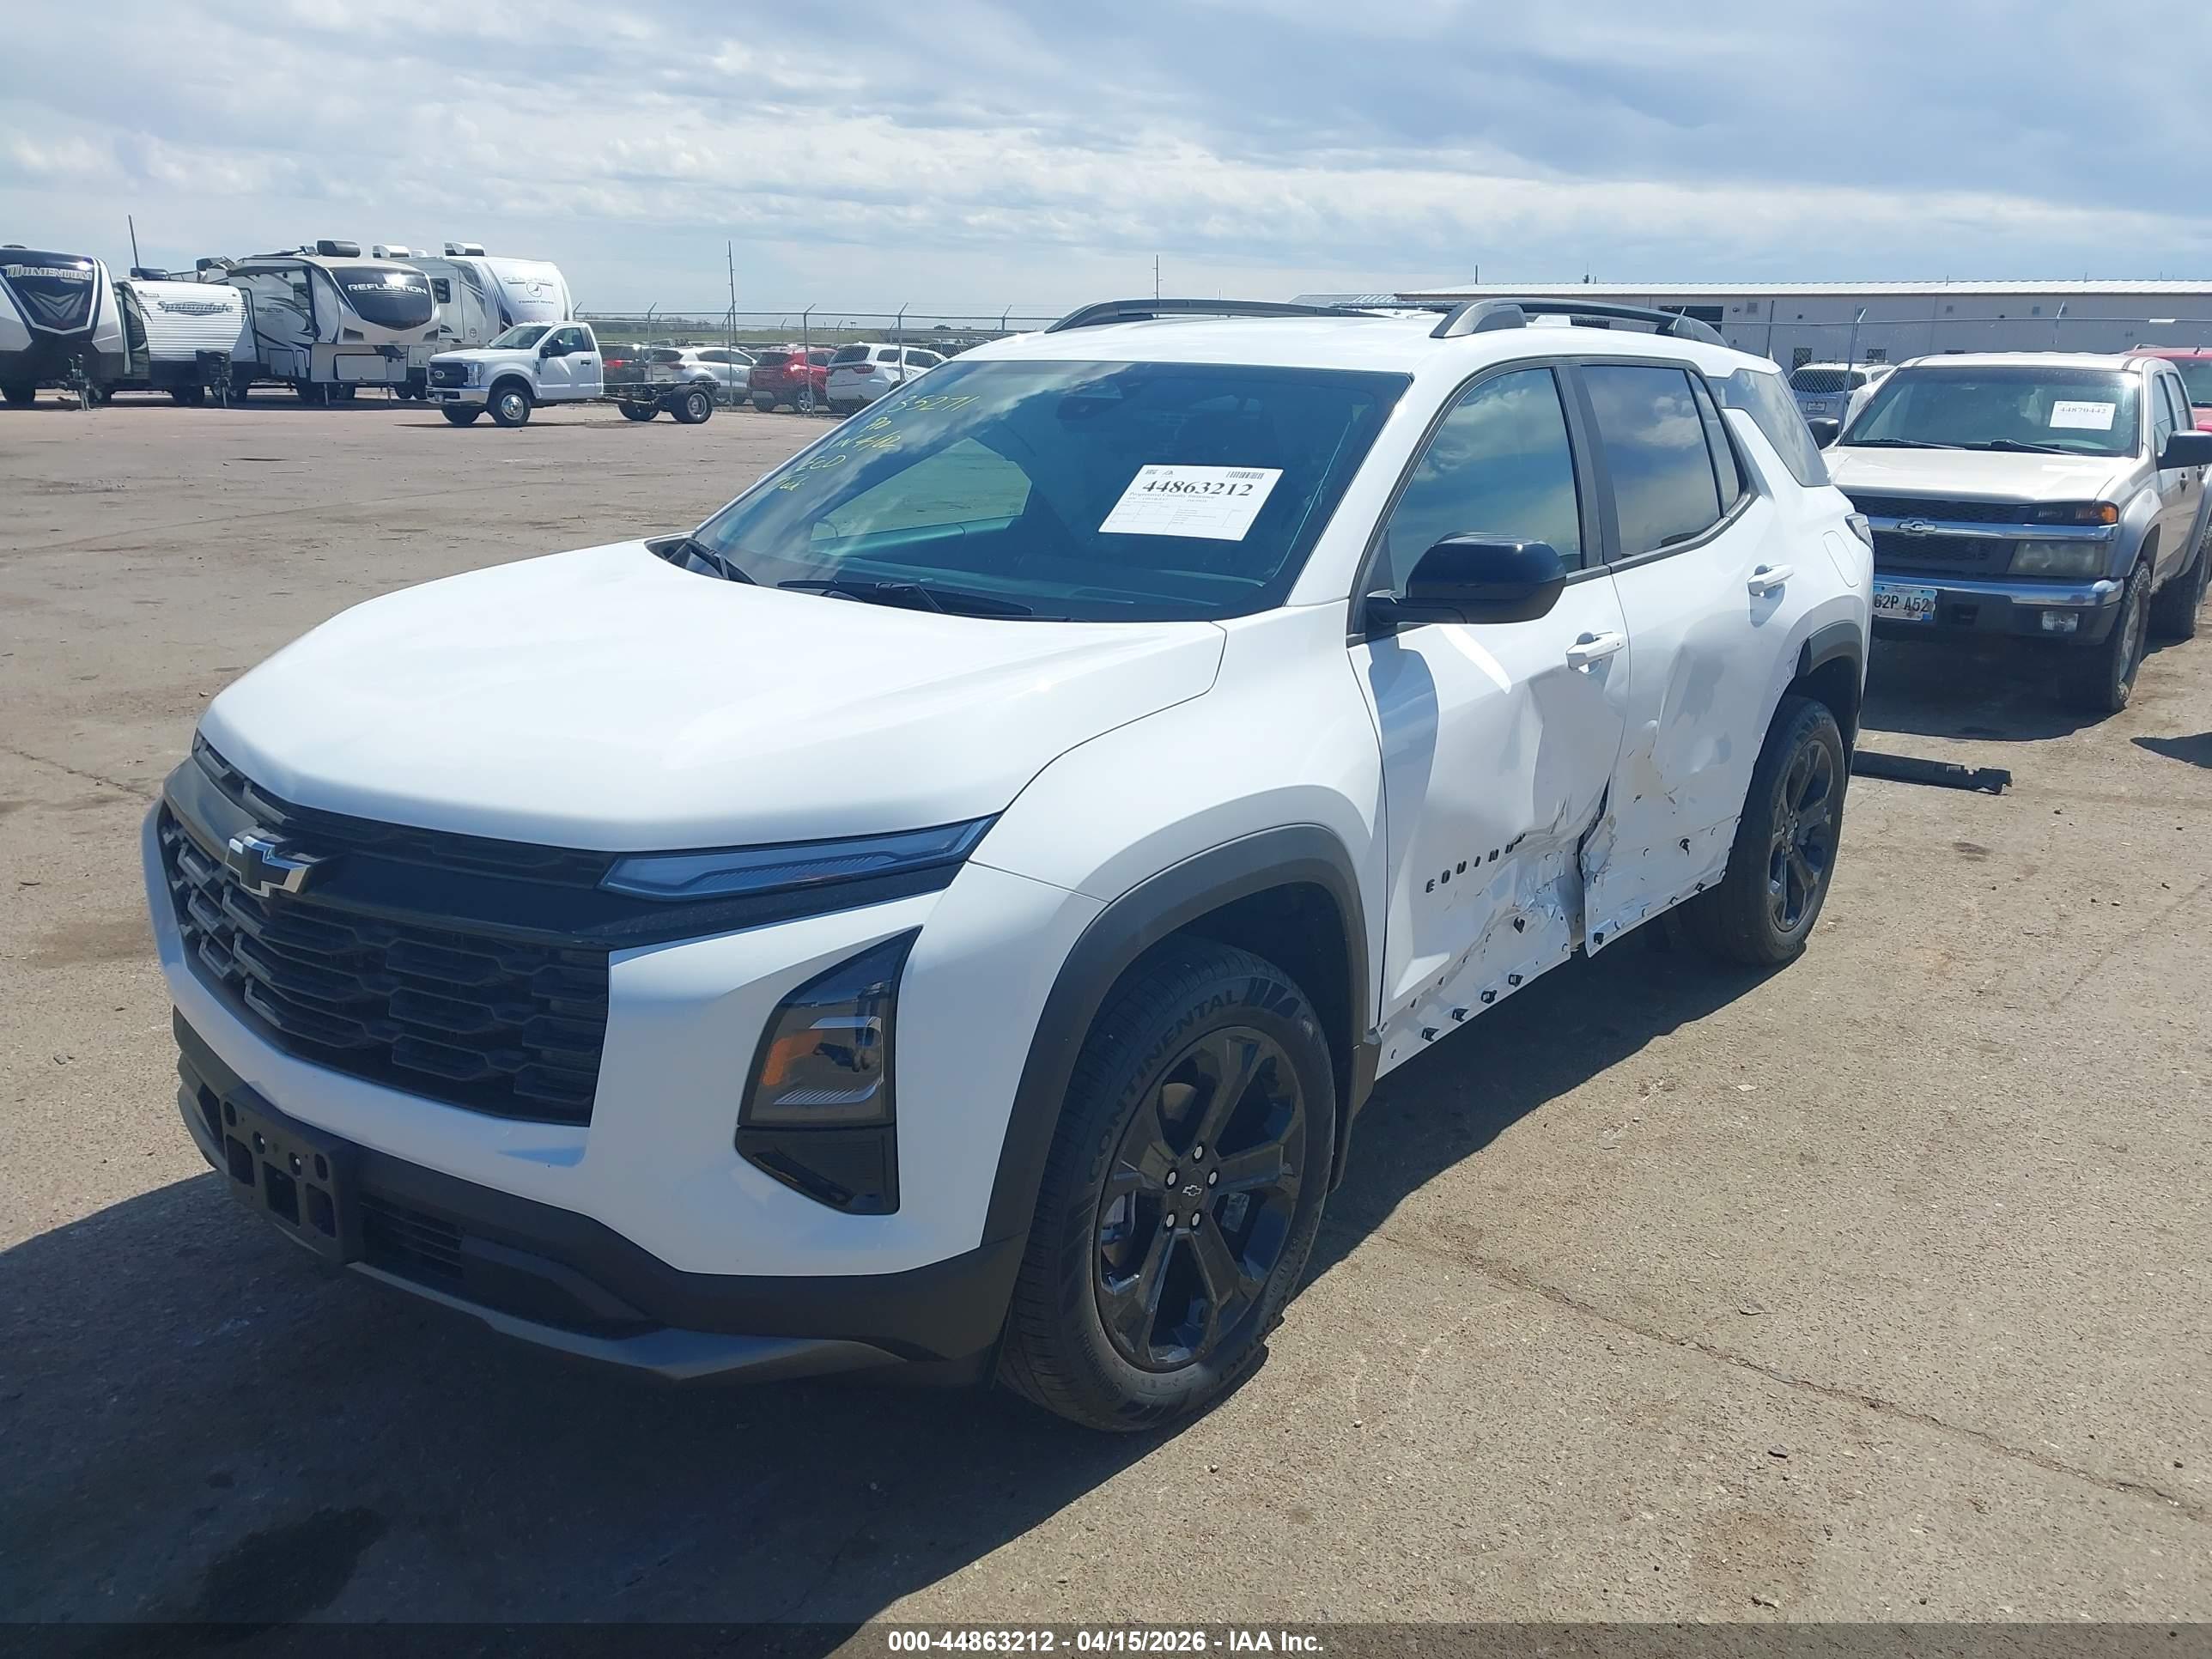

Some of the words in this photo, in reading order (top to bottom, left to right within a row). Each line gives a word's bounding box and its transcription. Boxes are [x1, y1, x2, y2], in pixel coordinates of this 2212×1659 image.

[348, 283, 428, 295] REFLECTION
[1142, 480, 1254, 496] 44863212
[1874, 593, 1899, 610] 62P
[1904, 596, 1929, 612] A52
